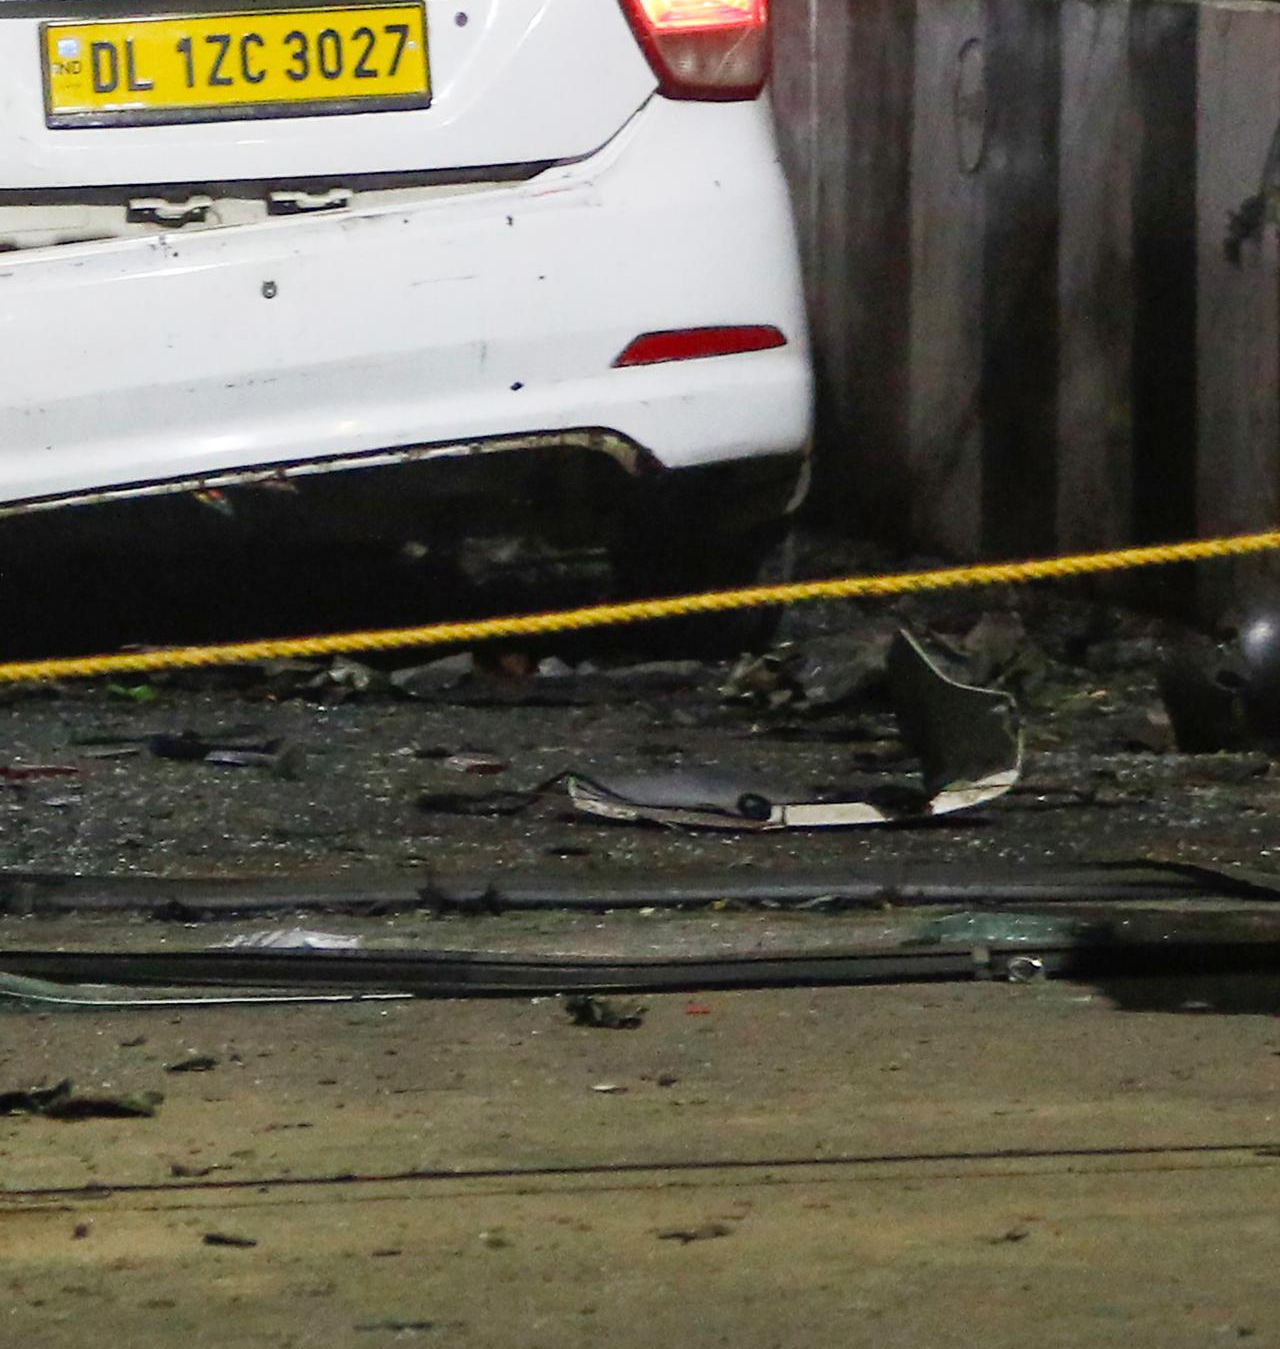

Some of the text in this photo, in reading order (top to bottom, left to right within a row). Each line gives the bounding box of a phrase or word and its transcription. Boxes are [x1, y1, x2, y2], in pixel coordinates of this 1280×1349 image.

[91, 23, 411, 93] DL 1ZC 3027
